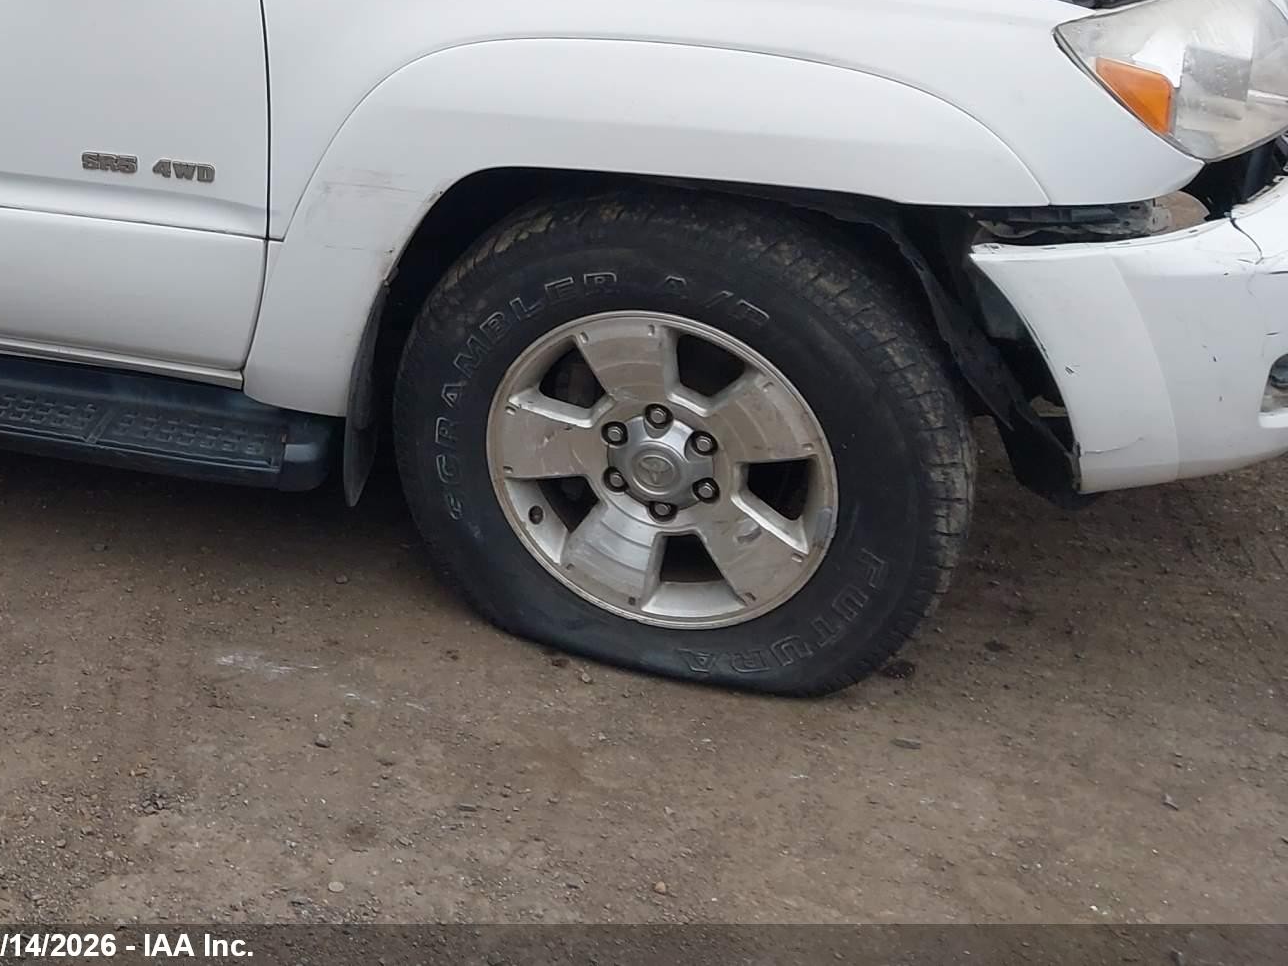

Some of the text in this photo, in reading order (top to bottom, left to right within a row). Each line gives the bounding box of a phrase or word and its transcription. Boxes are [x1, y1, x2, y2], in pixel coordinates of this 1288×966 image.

[81, 151, 215, 183] SR5 4WD
[675, 546, 889, 673] FUTURA
